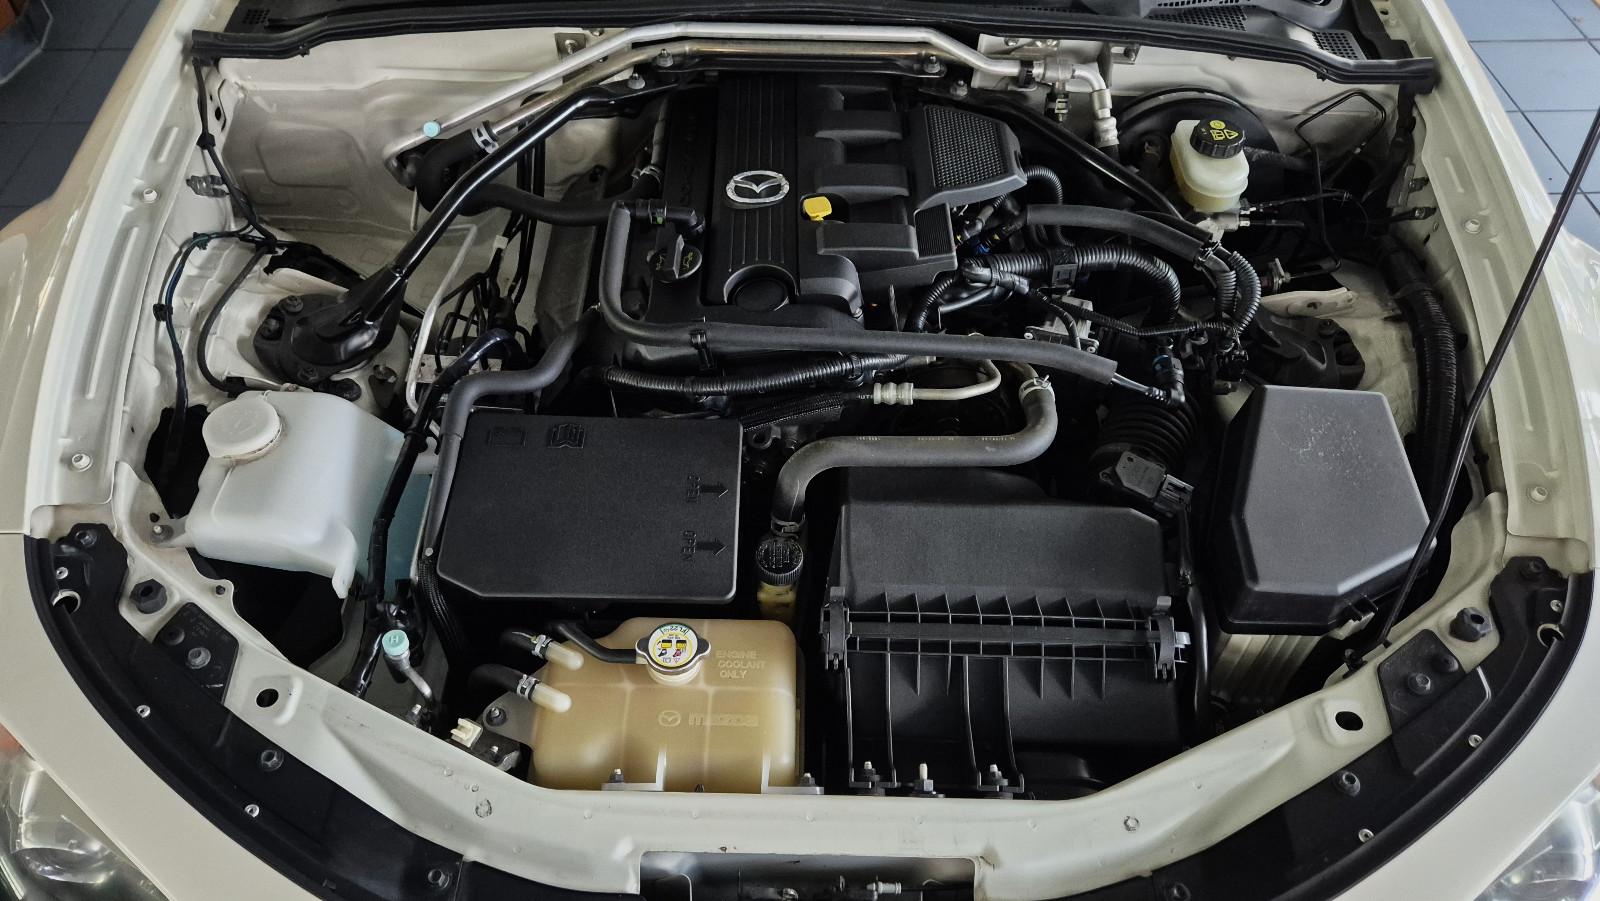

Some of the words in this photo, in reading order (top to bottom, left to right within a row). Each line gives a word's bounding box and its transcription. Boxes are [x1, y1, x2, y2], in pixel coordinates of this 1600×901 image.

[681, 530, 697, 561] OPEN
[390, 635, 399, 644] H
[715, 650, 758, 659] ENGINE
[718, 660, 766, 669] COOLANT
[719, 670, 748, 679] ONLY
